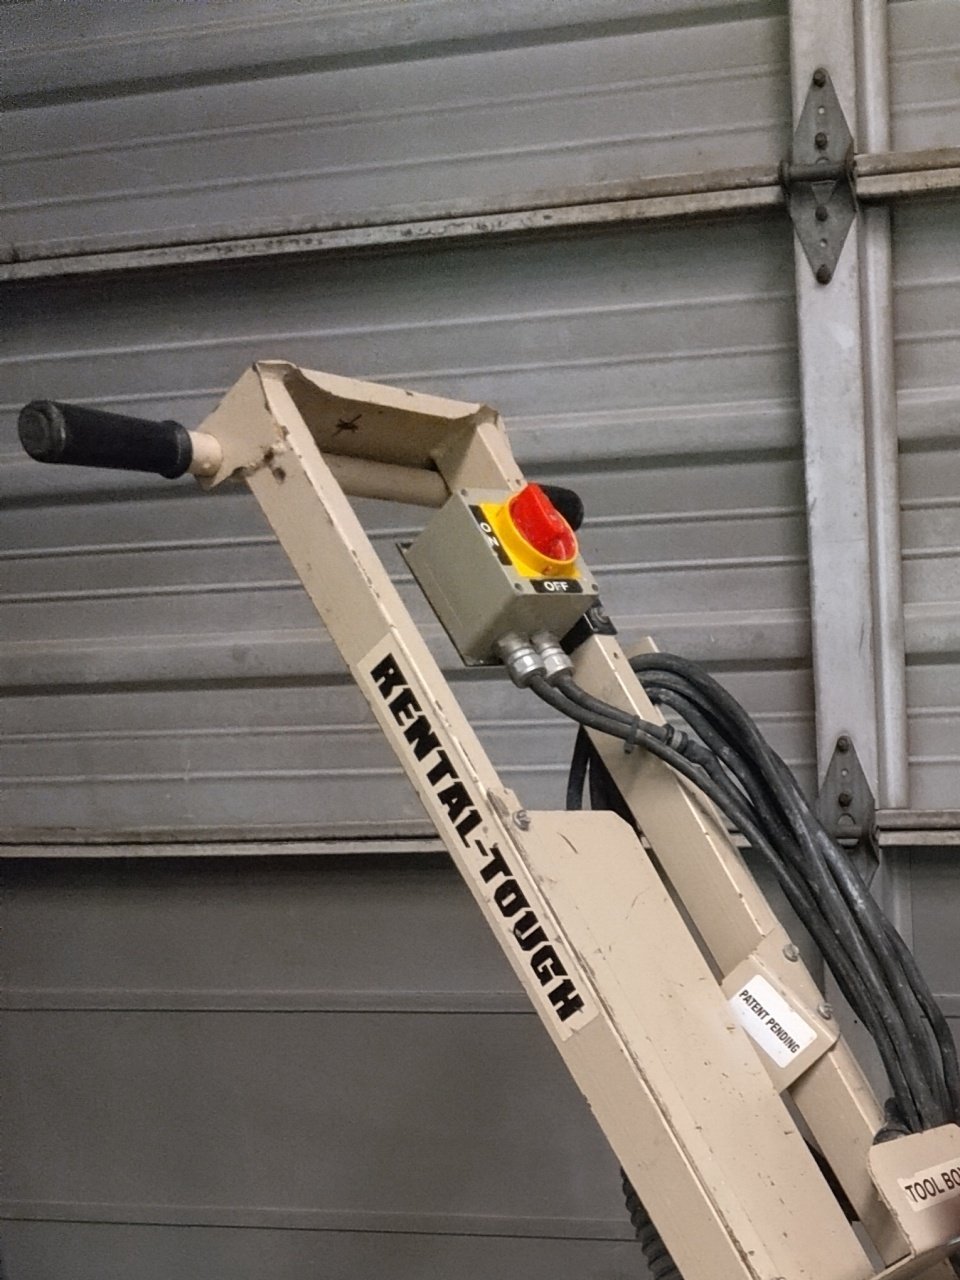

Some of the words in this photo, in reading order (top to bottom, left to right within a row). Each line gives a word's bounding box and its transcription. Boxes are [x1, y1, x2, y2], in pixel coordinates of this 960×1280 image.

[480, 522, 500, 547] ON
[543, 581, 569, 591] OFF
[739, 989, 770, 1021] PATENT
[766, 1016, 800, 1054] PENDING
[904, 1176, 945, 1203] TOOL
